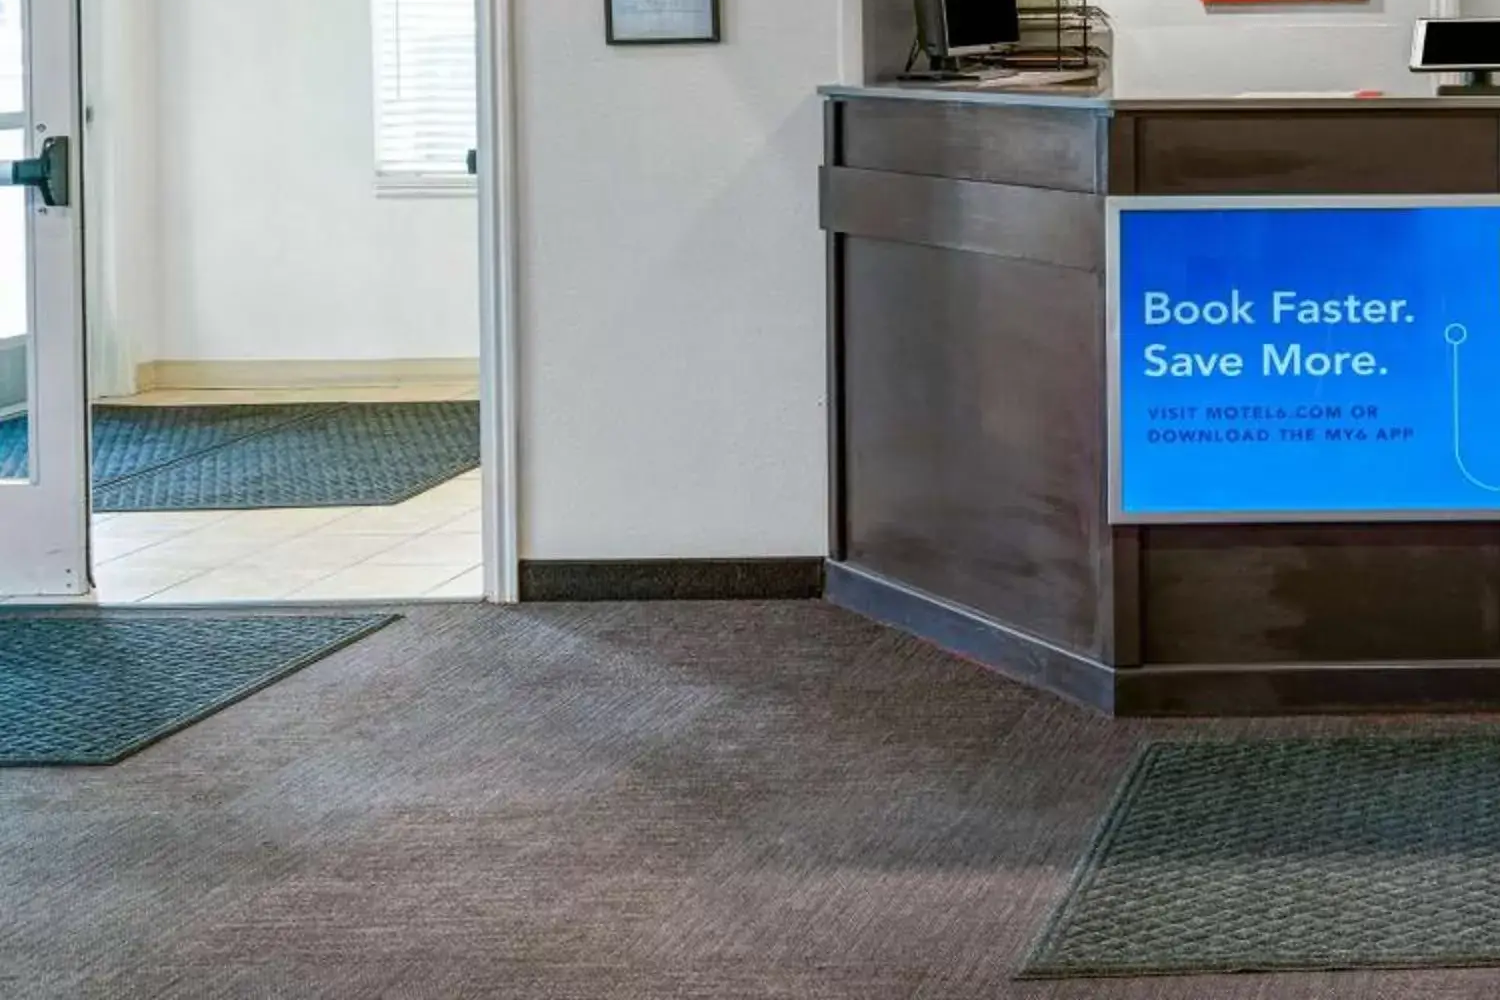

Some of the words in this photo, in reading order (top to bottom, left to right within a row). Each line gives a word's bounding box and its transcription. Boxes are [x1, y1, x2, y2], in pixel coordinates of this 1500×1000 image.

[1143, 289, 1255, 325] Book
[1272, 290, 1415, 325] Faster.
[1143, 343, 1243, 377] Save
[1262, 343, 1388, 377] More.
[1147, 405, 1197, 421] VISIT
[1205, 405, 1343, 420] MOTEL6.COM
[1350, 404, 1379, 420] OR
[1147, 428, 1270, 444] DOWNLOAD
[1279, 428, 1315, 442] THE
[1324, 427, 1369, 442] MY6
[1375, 427, 1415, 442] APP
